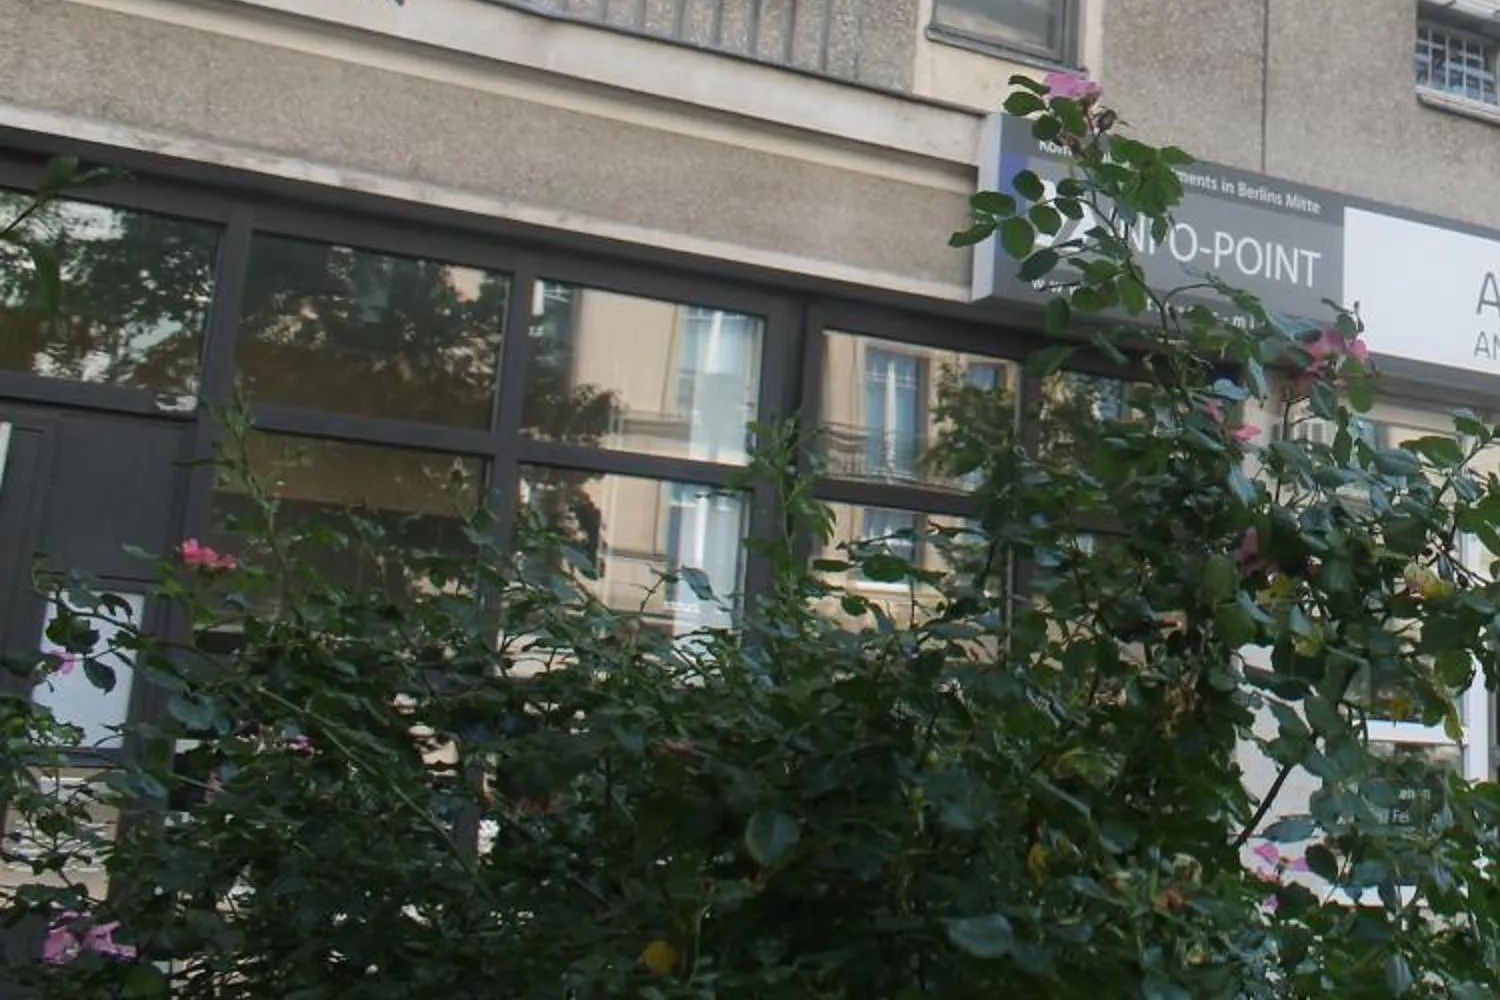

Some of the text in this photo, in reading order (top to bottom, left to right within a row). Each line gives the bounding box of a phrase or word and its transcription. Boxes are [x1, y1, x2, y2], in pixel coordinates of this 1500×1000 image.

[1221, 178, 1235, 194] in
[1237, 181, 1282, 206] Berlins
[1285, 192, 1321, 215] Mitte
